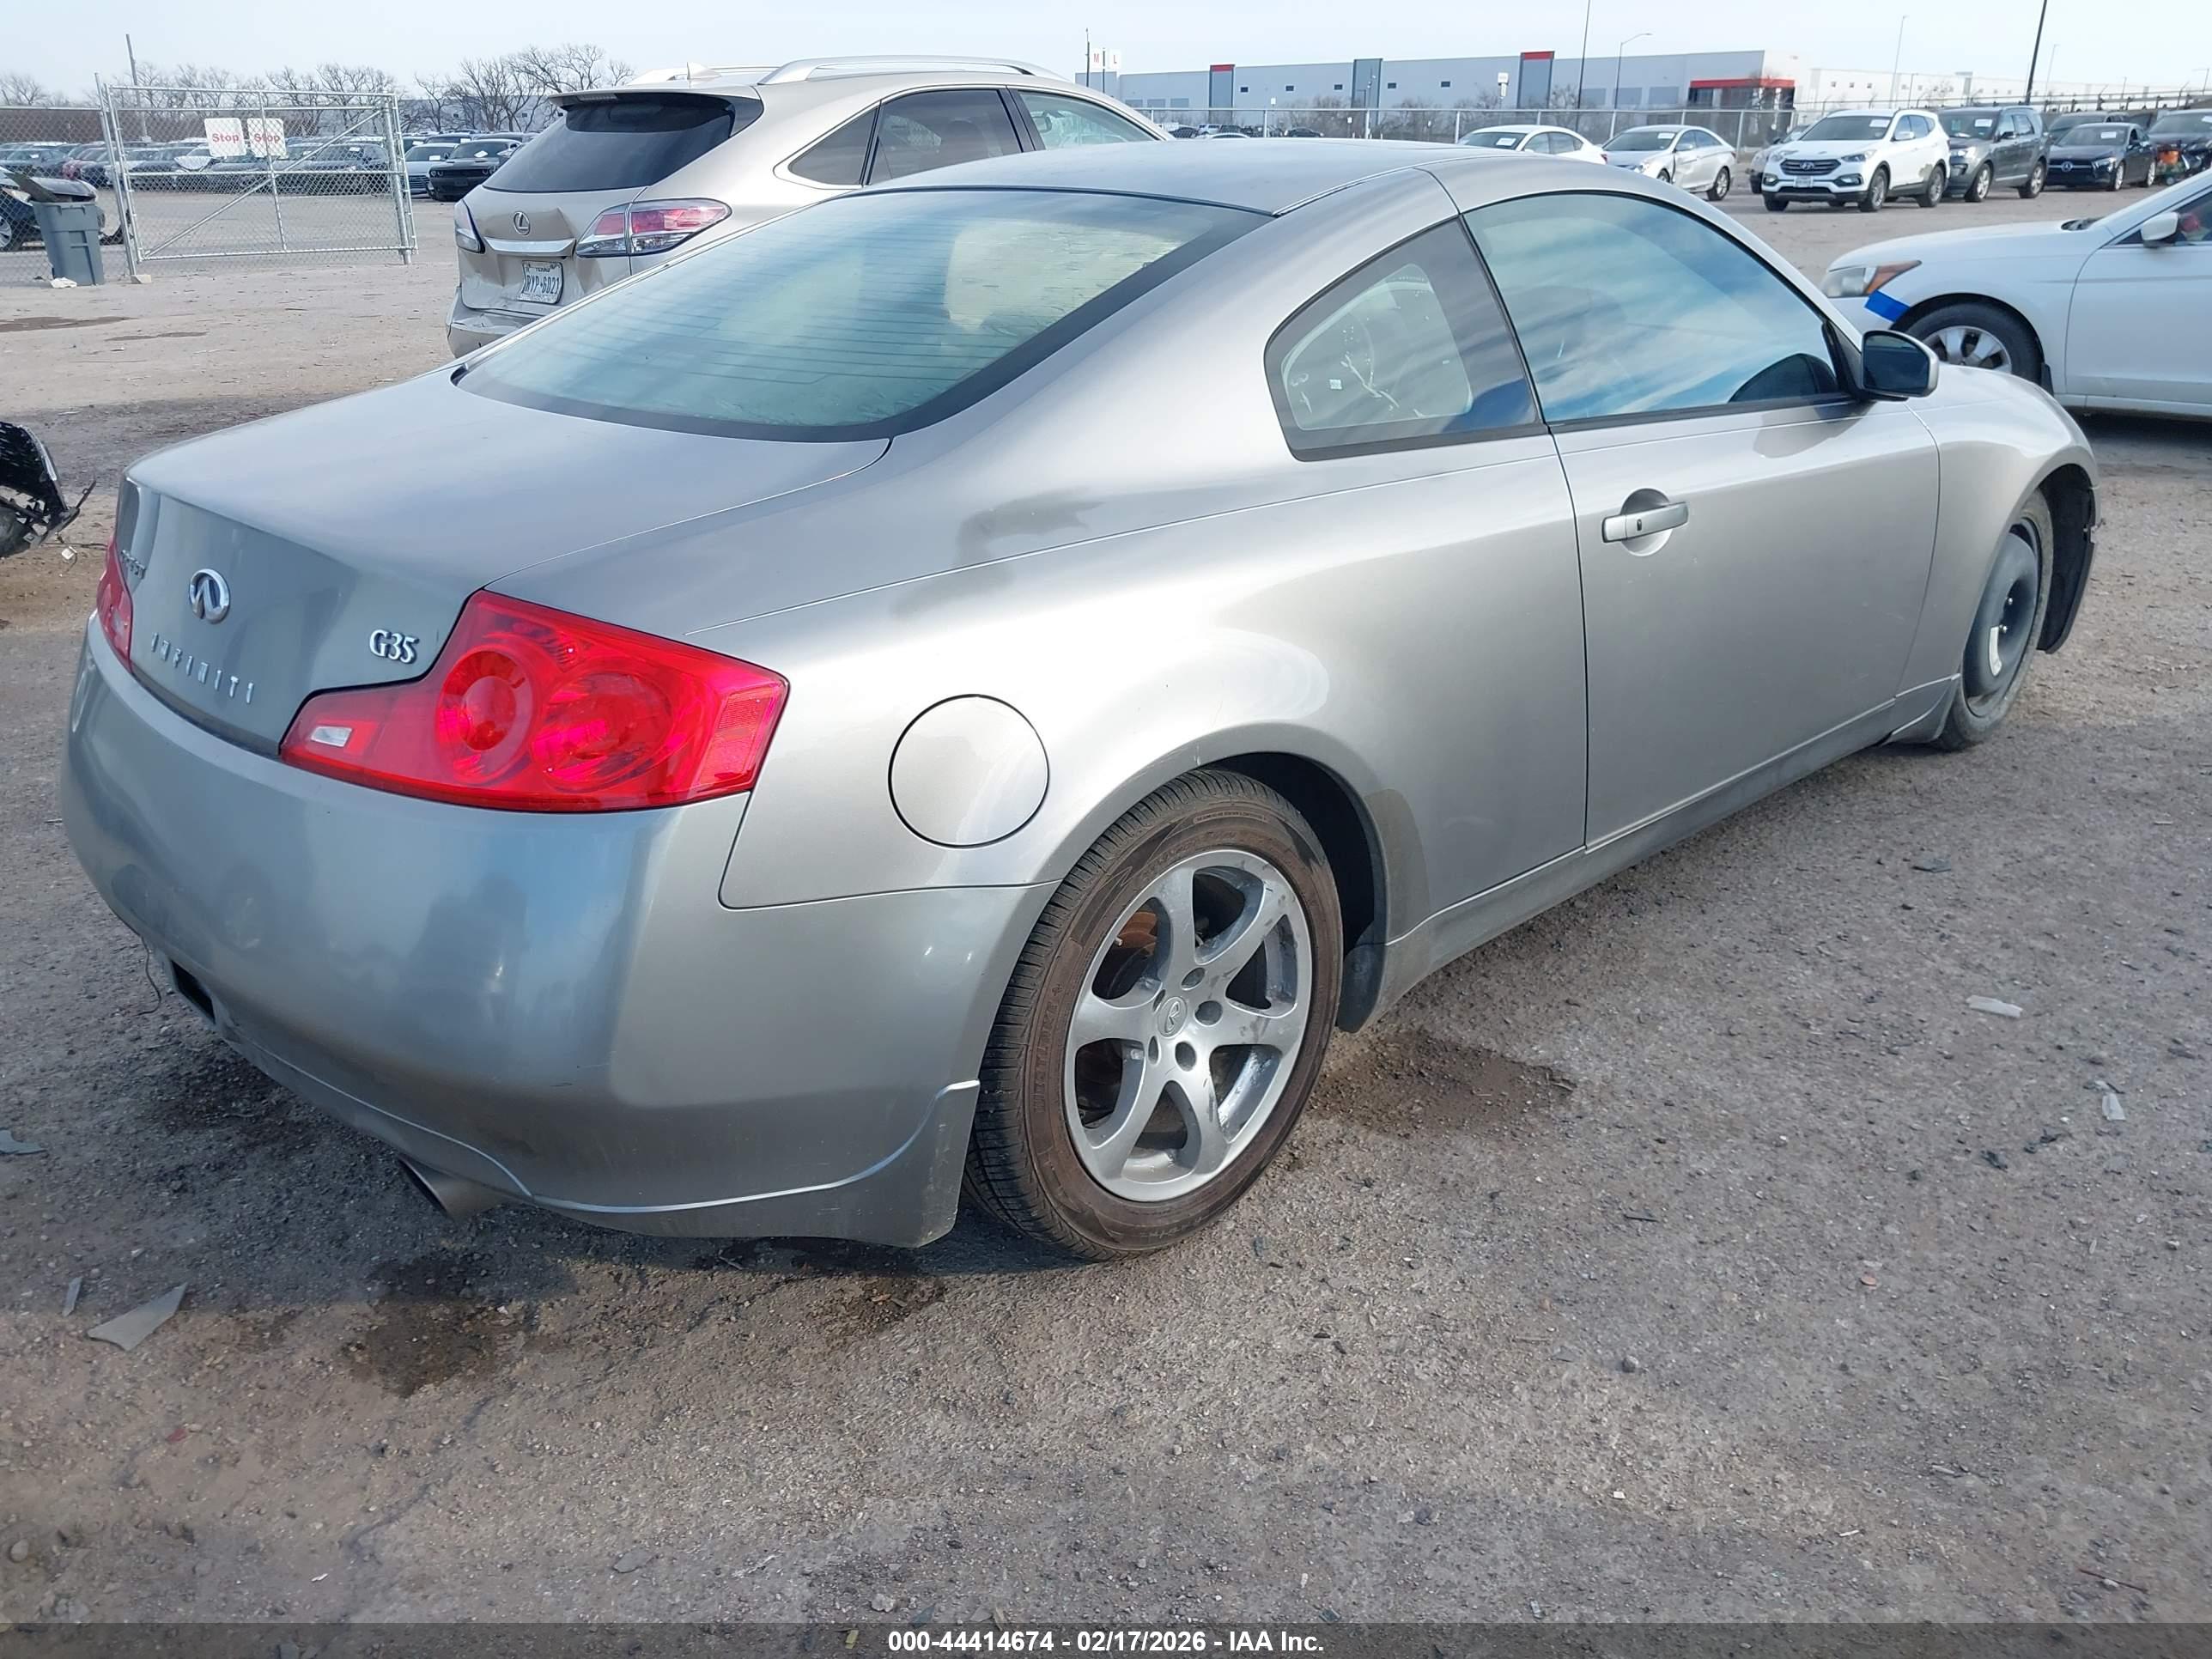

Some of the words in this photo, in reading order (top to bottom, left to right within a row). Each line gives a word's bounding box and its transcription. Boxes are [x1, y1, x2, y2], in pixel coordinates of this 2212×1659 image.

[212, 133, 240, 143] Stop
[254, 133, 281, 143] Stop
[369, 629, 419, 664] G35
[150, 632, 255, 704] INFINITI
